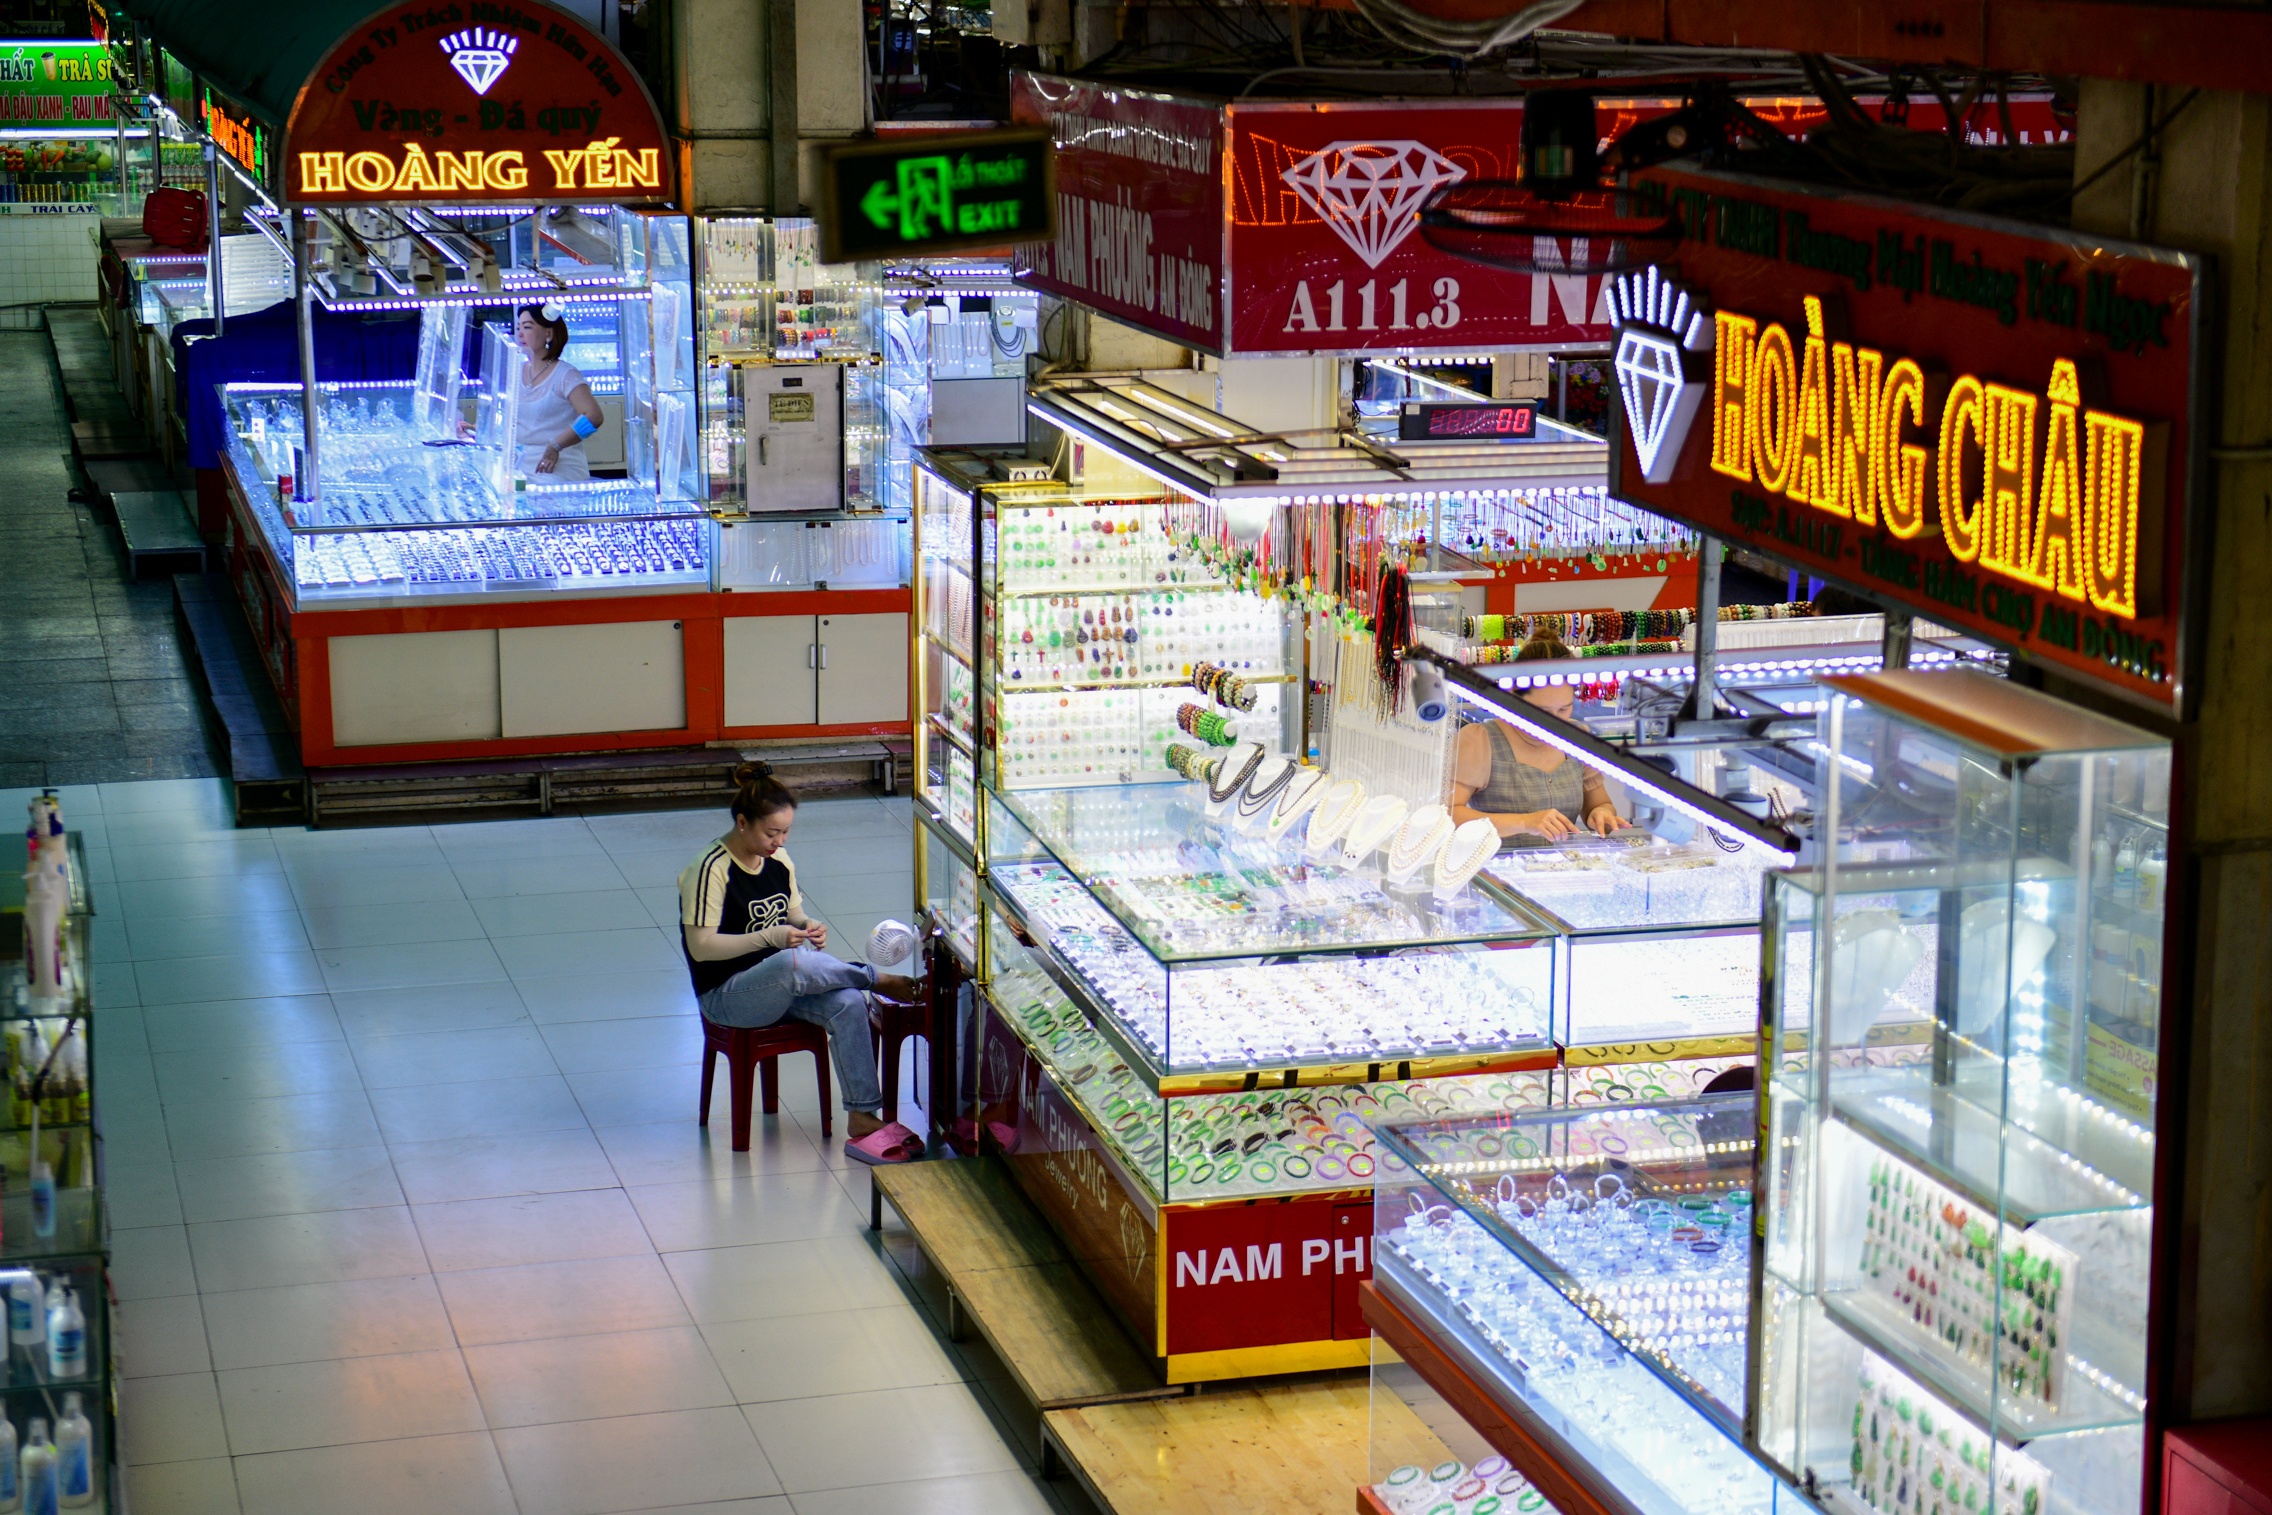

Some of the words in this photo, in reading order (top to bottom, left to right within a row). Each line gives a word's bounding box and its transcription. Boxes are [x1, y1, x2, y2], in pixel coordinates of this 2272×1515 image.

[369, 26, 398, 48] Ty
[400, 2, 463, 34] Trách
[59, 52, 93, 81] TRÀ
[12, 91, 34, 125] ĐẬU
[36, 95, 63, 119] XANH
[72, 95, 91, 119] RAU
[352, 99, 444, 137] Vàng
[480, 99, 525, 131] Đá
[538, 100, 602, 136] quý
[299, 143, 528, 193] HOÀNG
[542, 136, 660, 190] YẾN
[1065, 112, 1085, 148] TNHH
[1087, 116, 1105, 152] KINH
[1107, 119, 1133, 158] DOANH
[1135, 115, 1158, 164] VÀNG
[1191, 128, 1212, 175] QUÝ
[959, 199, 1021, 233] EXIT
[1055, 192, 1087, 289] NAM
[1090, 184, 1155, 311] PHƯƠNG
[1160, 253, 1176, 319] AN
[1179, 245, 1212, 331] ĐÔNG
[1714, 196, 1780, 259] TNHH
[1876, 229, 1925, 304] Mại
[2025, 257, 2077, 327] Yến
[2083, 268, 2171, 357] Ngọc
[1283, 277, 1461, 332] A111.3
[1709, 295, 1927, 540] HOÀNG
[1937, 357, 2144, 619] CHÂU
[2038, 603, 2077, 651] AN
[1017, 1047, 1045, 1132] NAM
[1045, 1151, 1080, 1210] Jewelry
[1176, 1242, 1282, 1287] NAM
[1301, 1236, 1374, 1276] PH
